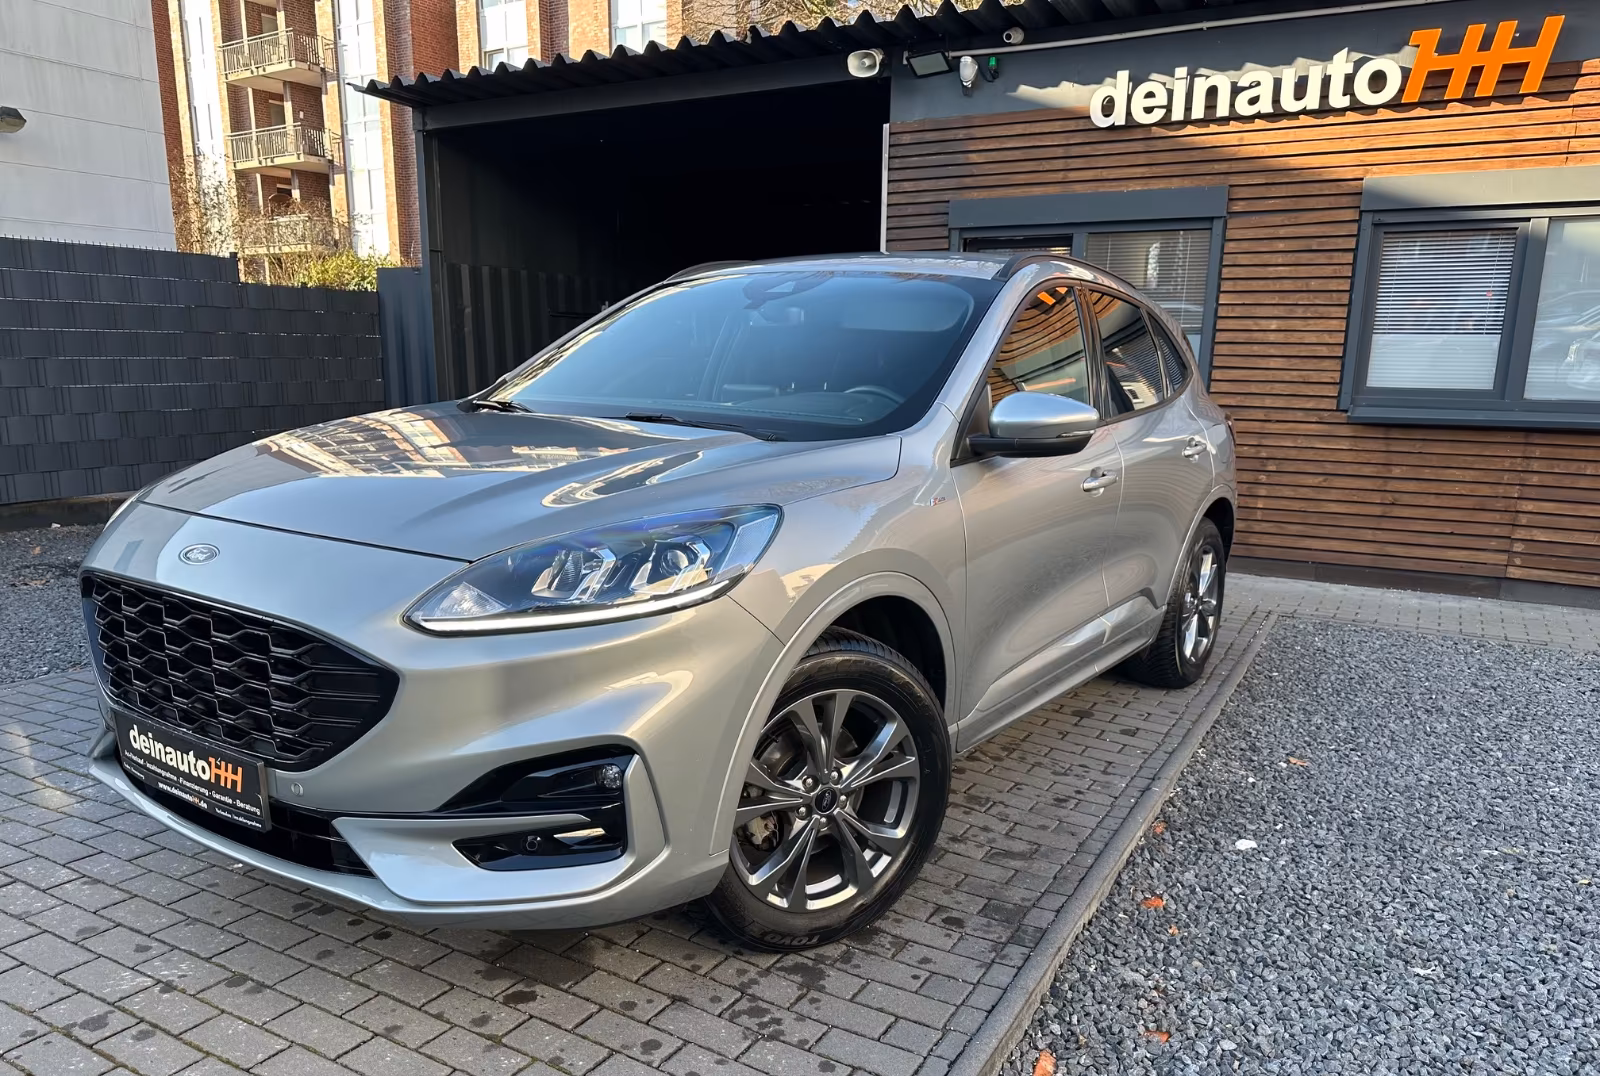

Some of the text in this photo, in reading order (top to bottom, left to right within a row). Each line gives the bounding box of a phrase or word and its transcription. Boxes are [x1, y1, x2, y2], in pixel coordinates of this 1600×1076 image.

[179, 777, 209, 797] Finanzierung
[212, 790, 233, 805] Garantie
[236, 799, 261, 816] Beratung
